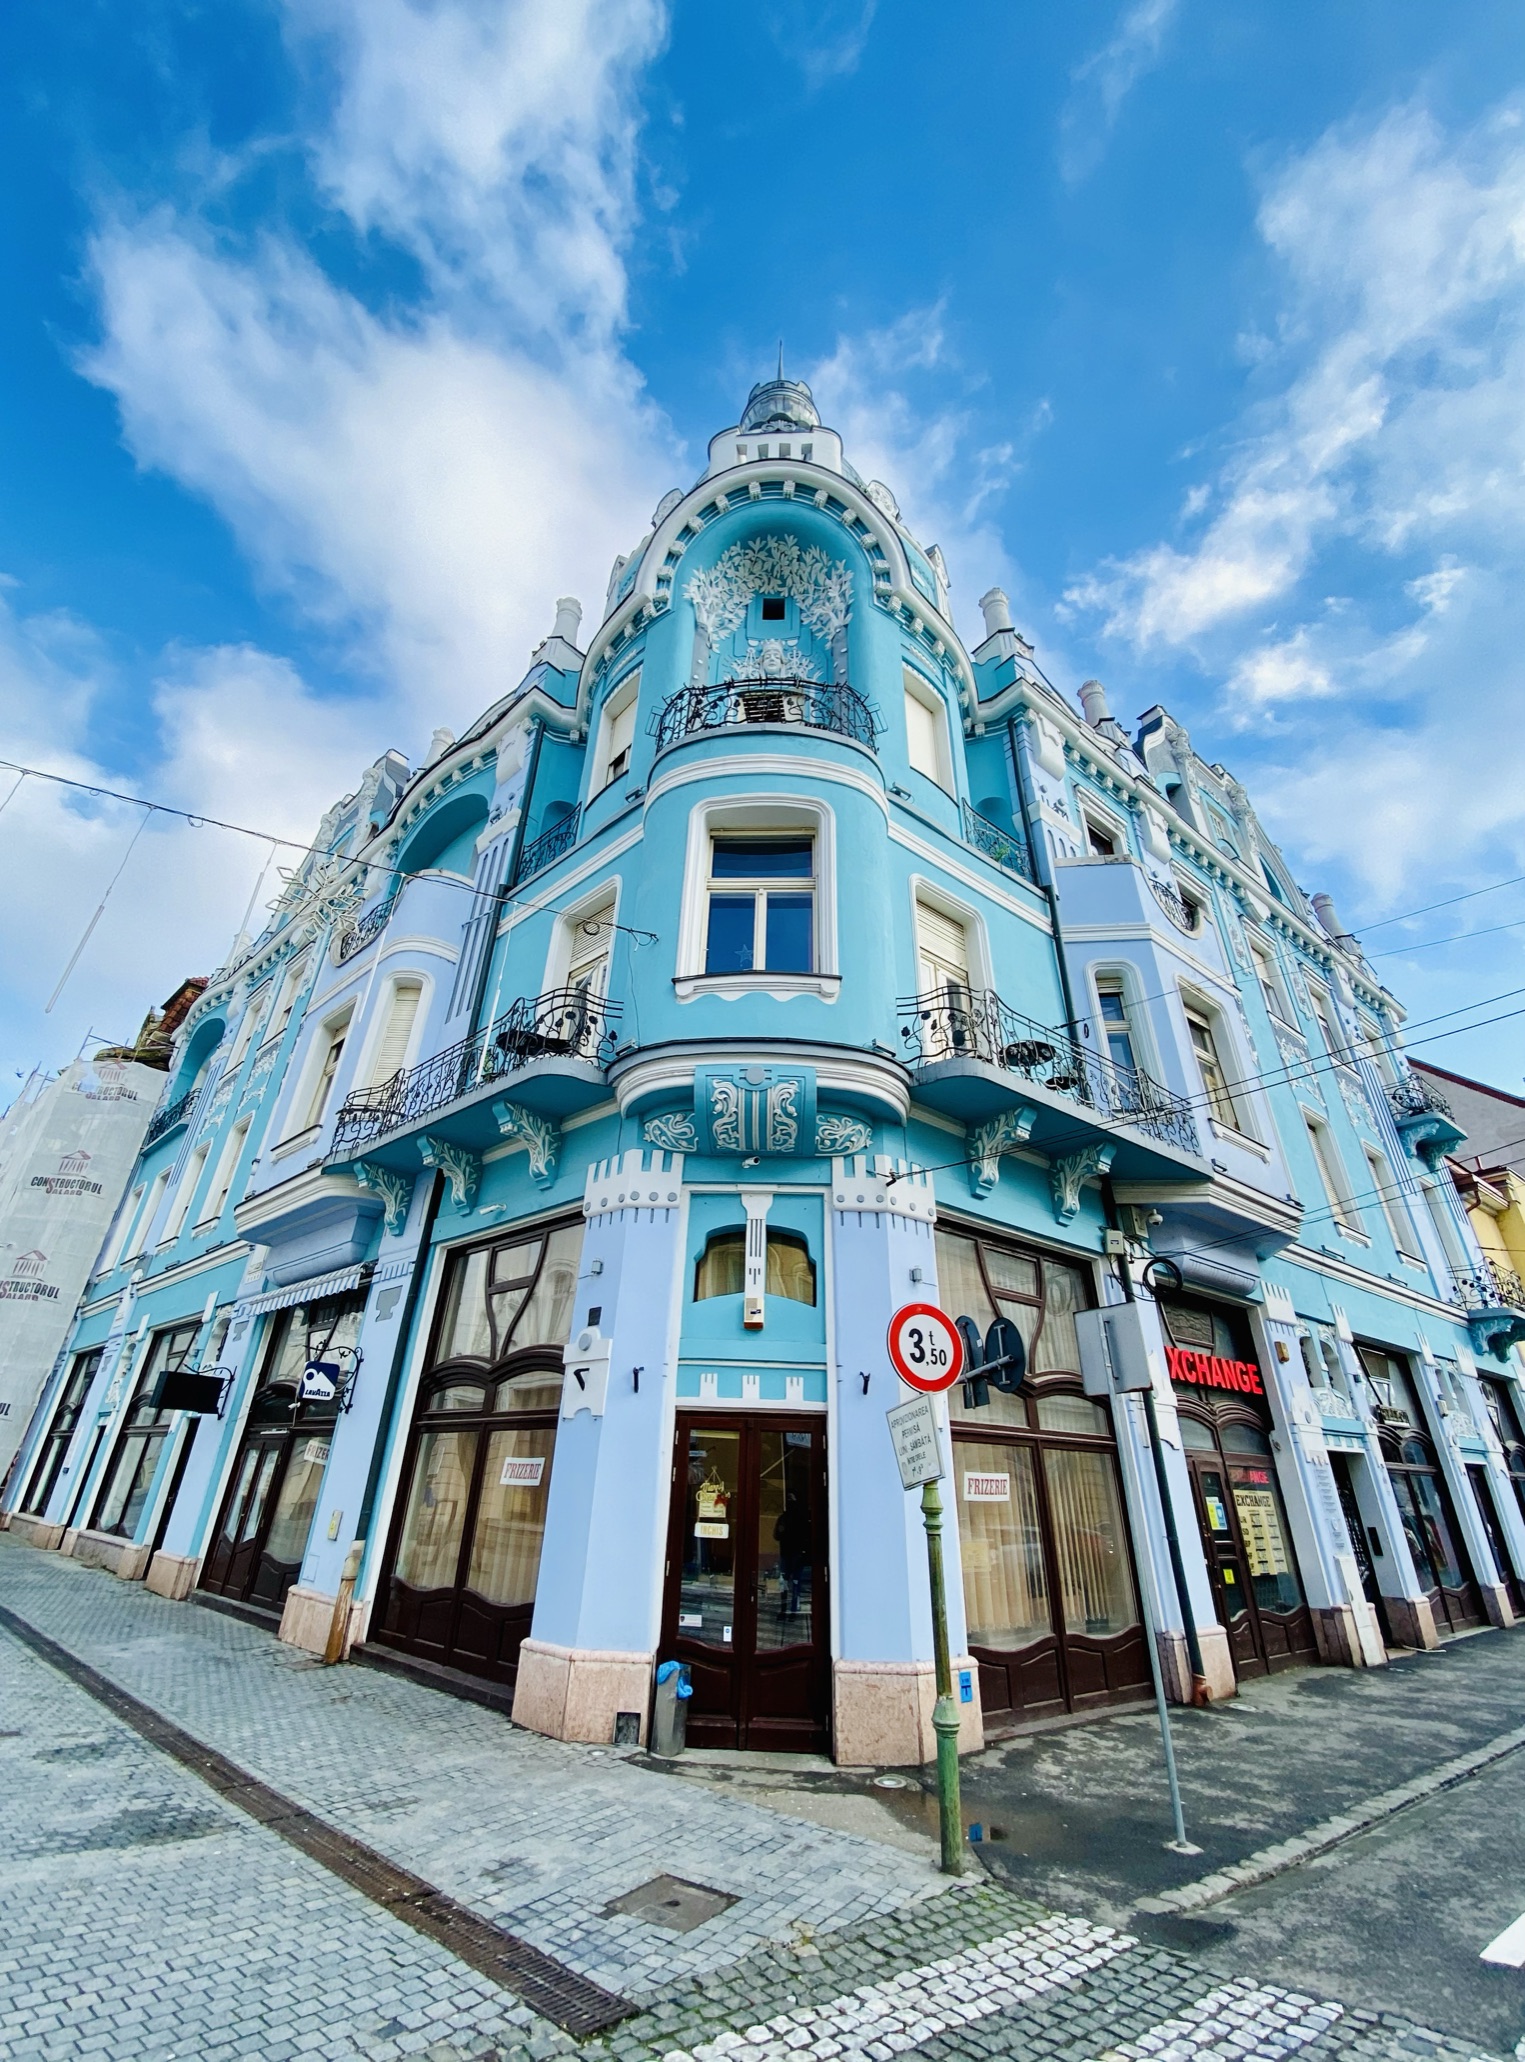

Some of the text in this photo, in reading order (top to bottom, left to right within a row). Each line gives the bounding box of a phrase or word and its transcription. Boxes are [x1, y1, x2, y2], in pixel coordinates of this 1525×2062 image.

[30, 1176, 103, 1195] CONSTRUCTORUL
[304, 1388, 331, 1398] LAVAZZA
[504, 1463, 542, 1479] FRIZERIE
[967, 1477, 1008, 1495] FRIZERIE
[1235, 1494, 1271, 1508] EXCHANGE
